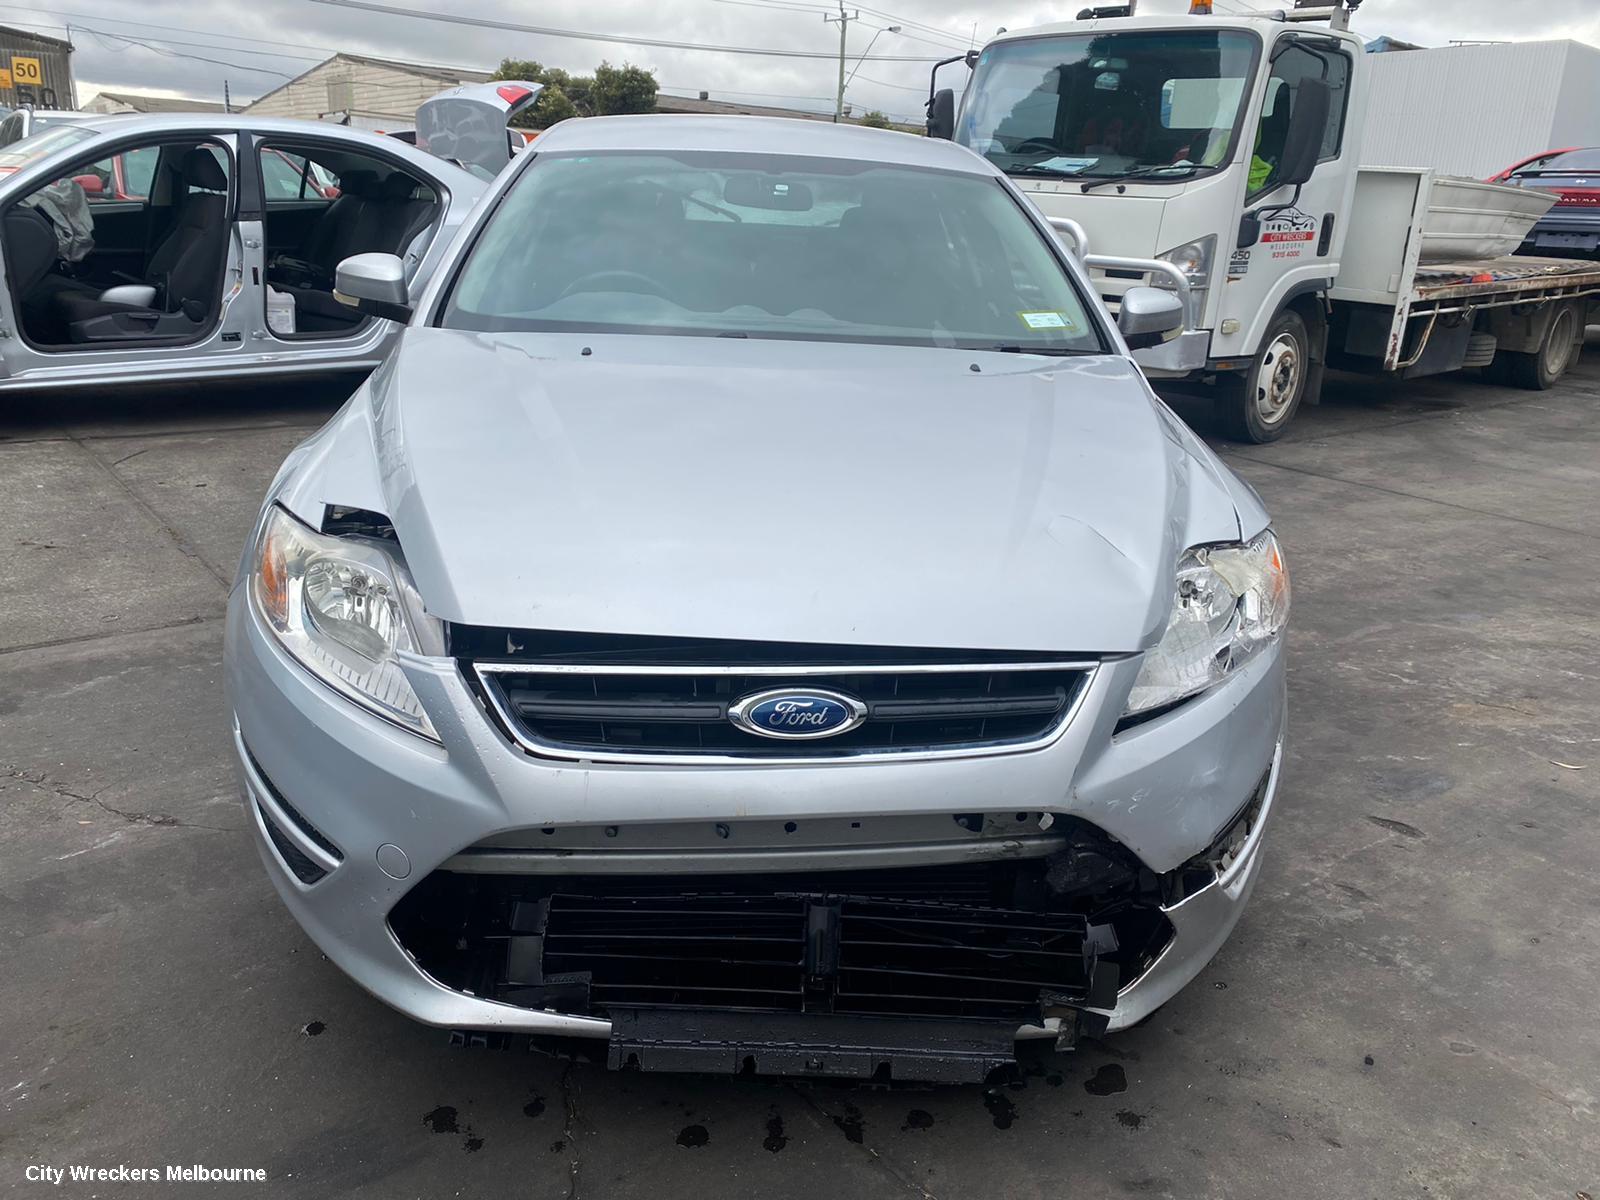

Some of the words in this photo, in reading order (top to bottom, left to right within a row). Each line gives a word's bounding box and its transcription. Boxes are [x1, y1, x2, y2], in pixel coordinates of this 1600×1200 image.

[16, 63, 37, 78] 50
[1270, 233, 1281, 241] CITY
[1282, 232, 1307, 240] WRECKERS
[1231, 250, 1250, 260] 450
[769, 701, 828, 725] Ford
